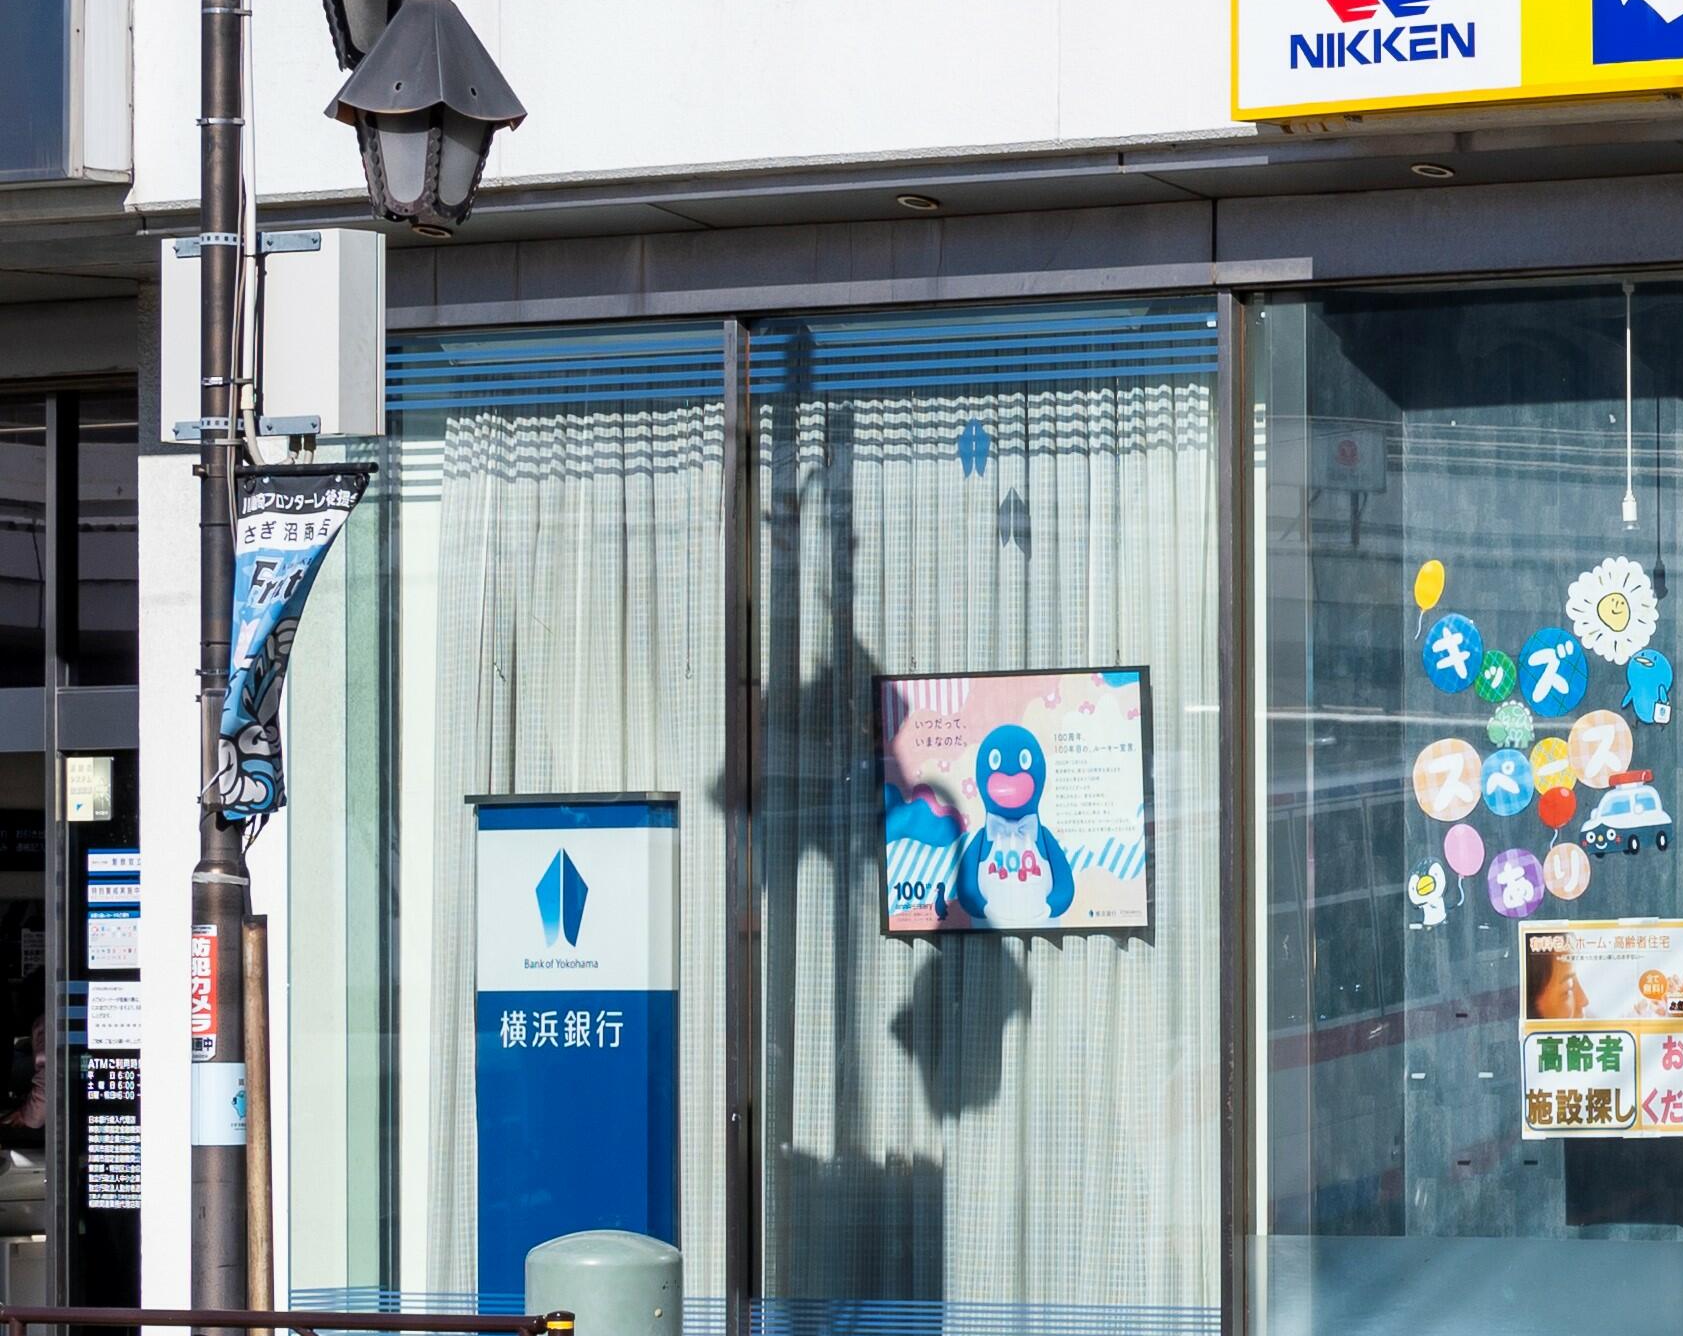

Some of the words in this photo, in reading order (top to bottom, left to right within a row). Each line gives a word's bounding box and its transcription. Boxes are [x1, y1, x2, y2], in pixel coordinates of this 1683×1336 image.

[1290, 21, 1477, 70] NIKKEN
[1432, 626, 1576, 704] キッズ
[914, 717, 967, 730] いつだって、
[915, 735, 968, 748] いまなのだ。
[1430, 723, 1623, 813] スペース
[1497, 853, 1579, 909] あり
[524, 958, 545, 969] Bank
[545, 958, 554, 969] of
[556, 958, 599, 969] Yokohama
[500, 1009, 624, 1049] 横浜銀行
[1536, 1035, 1624, 1073] 高齢者
[1525, 1087, 1635, 1125] 施設探し
